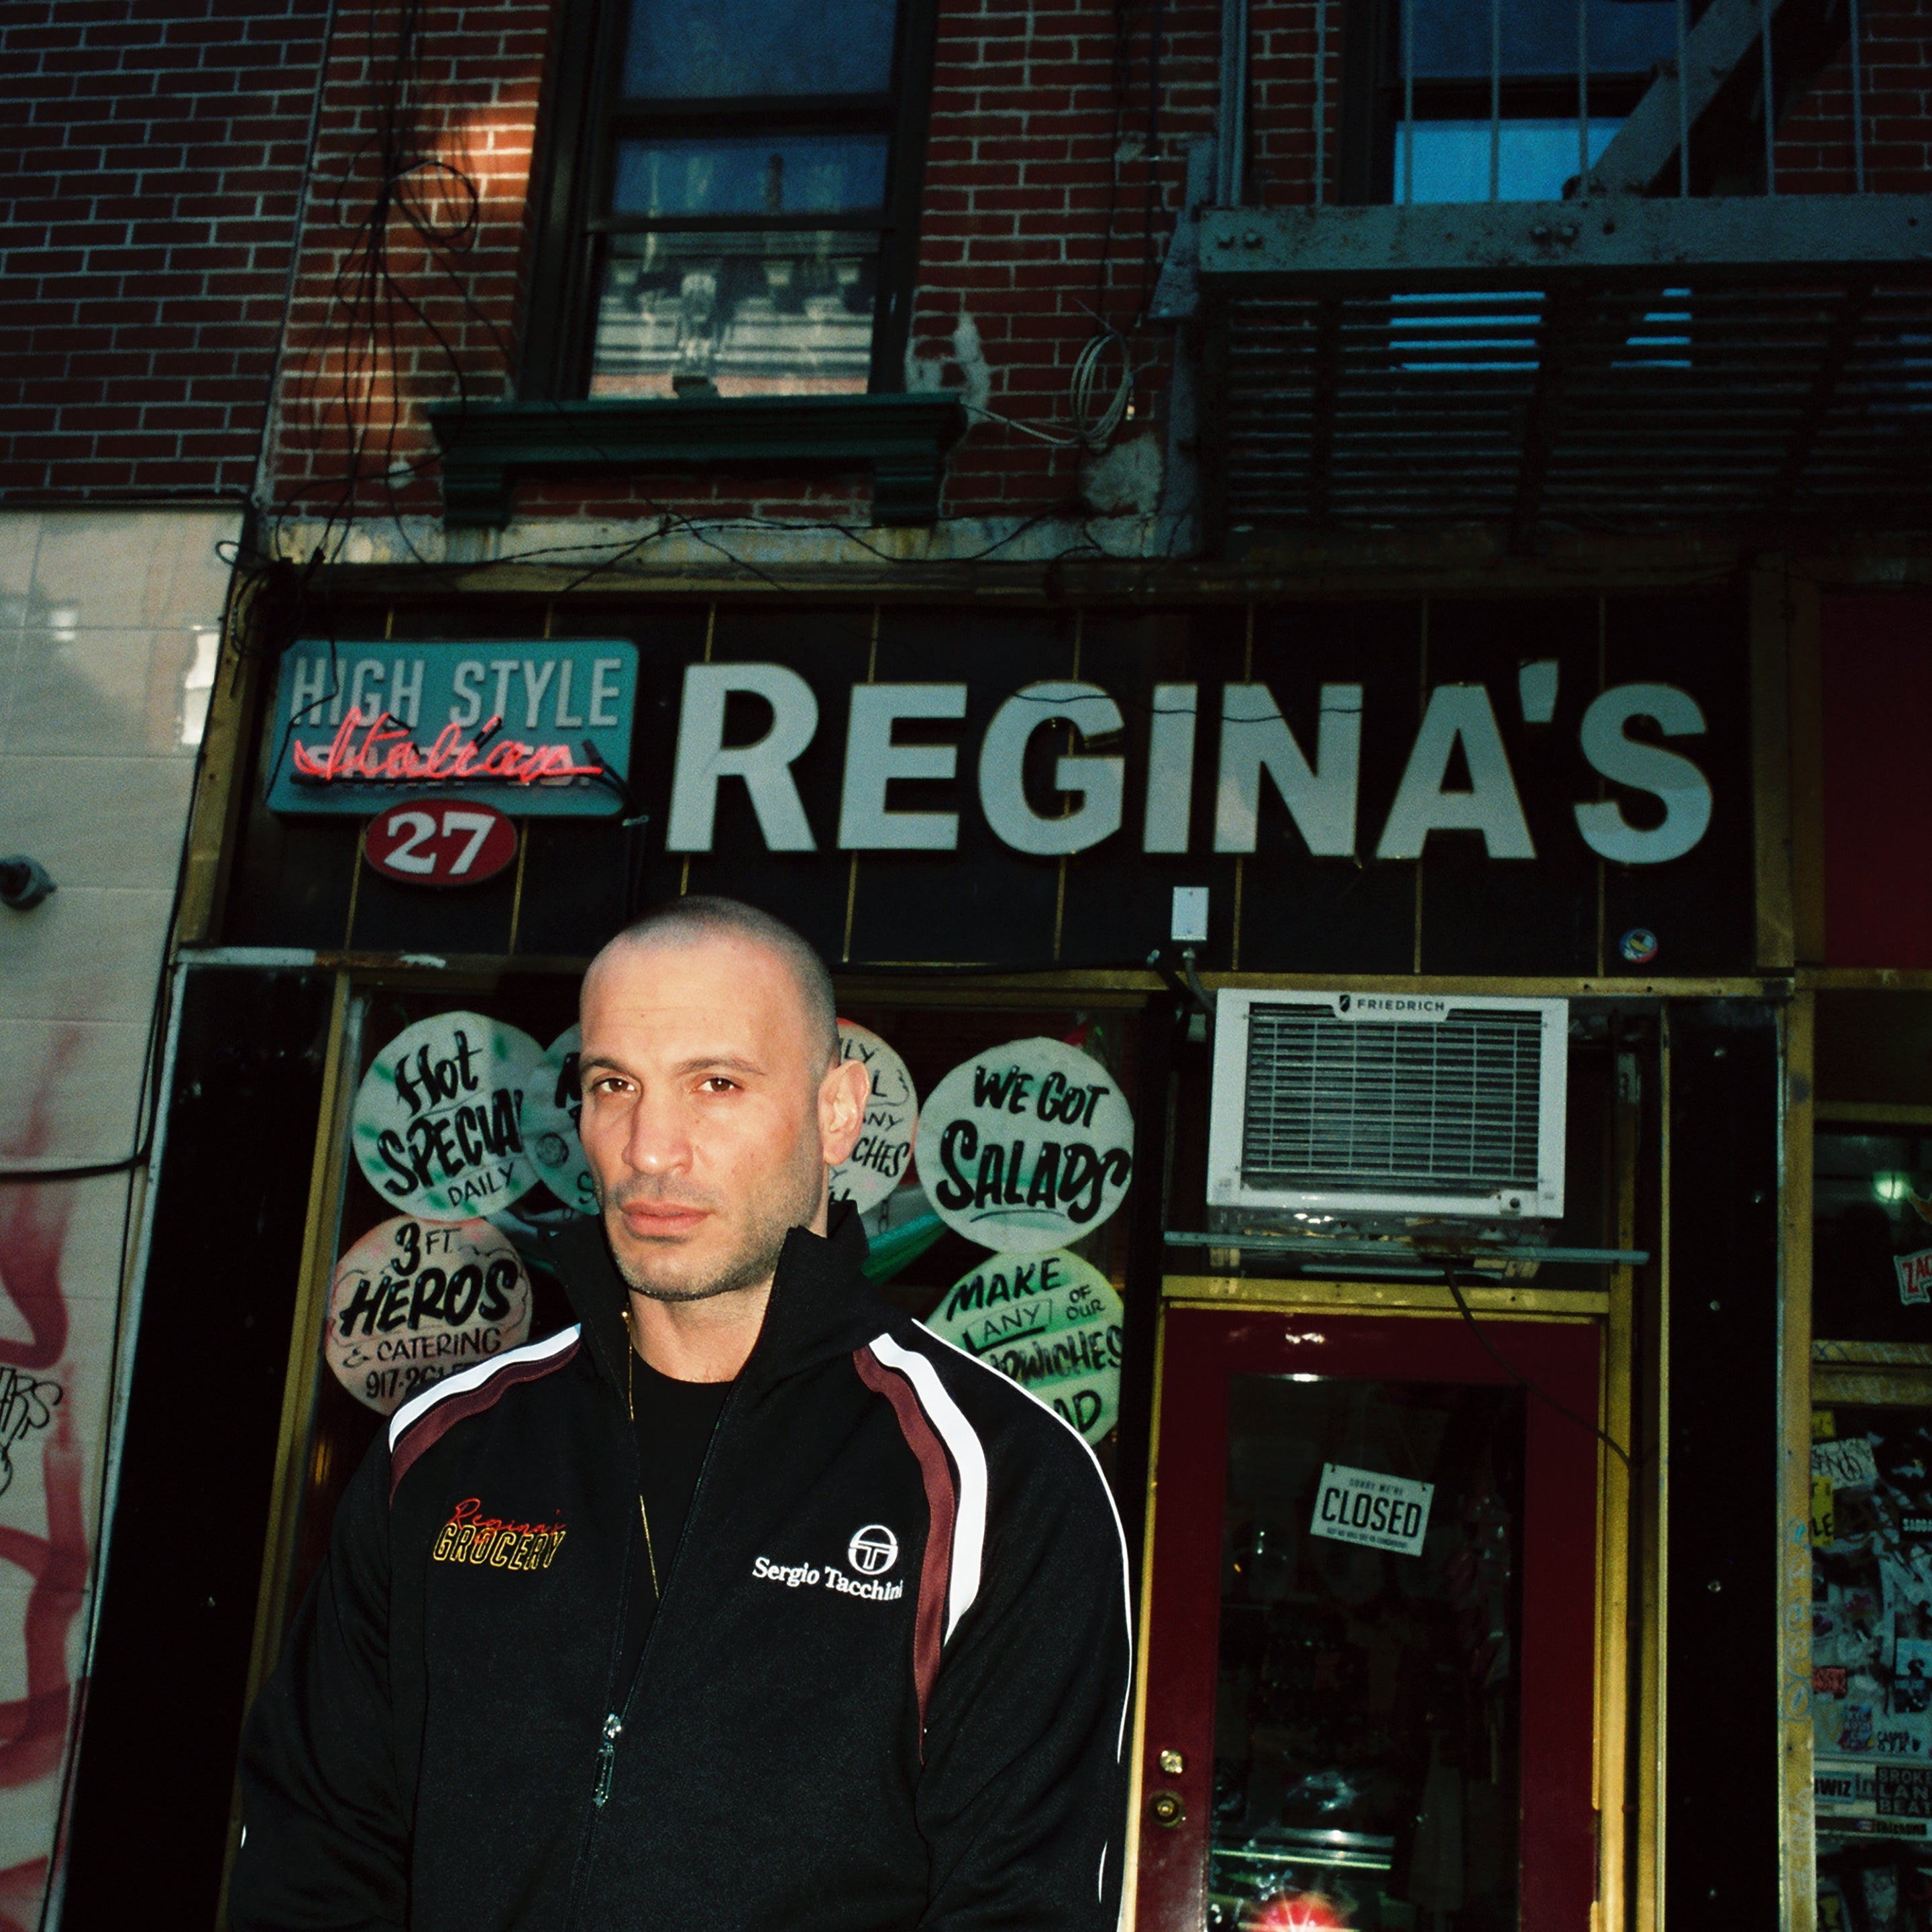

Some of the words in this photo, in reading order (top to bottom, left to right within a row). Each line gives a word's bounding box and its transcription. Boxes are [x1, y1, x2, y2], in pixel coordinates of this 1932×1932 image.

[291, 657, 425, 729] HIGH
[450, 657, 622, 729] STYLE
[294, 706, 602, 783] Italian
[665, 659, 1714, 865] REGINA'S
[383, 811, 496, 875] 27
[1356, 998, 1445, 1012] FRIEDRICH
[395, 1029, 482, 1117] Hot
[974, 1064, 1034, 1114] WE
[1036, 1071, 1110, 1128] GOT
[376, 1088, 524, 1197] SPECIA
[936, 1119, 1132, 1224] SALADS
[447, 1162, 515, 1208] DAILY
[391, 1222, 421, 1277] 3
[339, 1259, 519, 1337] HEROS
[947, 1257, 1064, 1322] MAKE
[1065, 1299, 1106, 1320] OUR
[1069, 1284, 1091, 1303] OF
[376, 1327, 501, 1362] CATERING
[1321, 1487, 1423, 1538] CLOSED
[433, 1522, 566, 1570] GROCERY
[752, 1556, 820, 1588] Sergio
[824, 1565, 904, 1601] Tacchini
